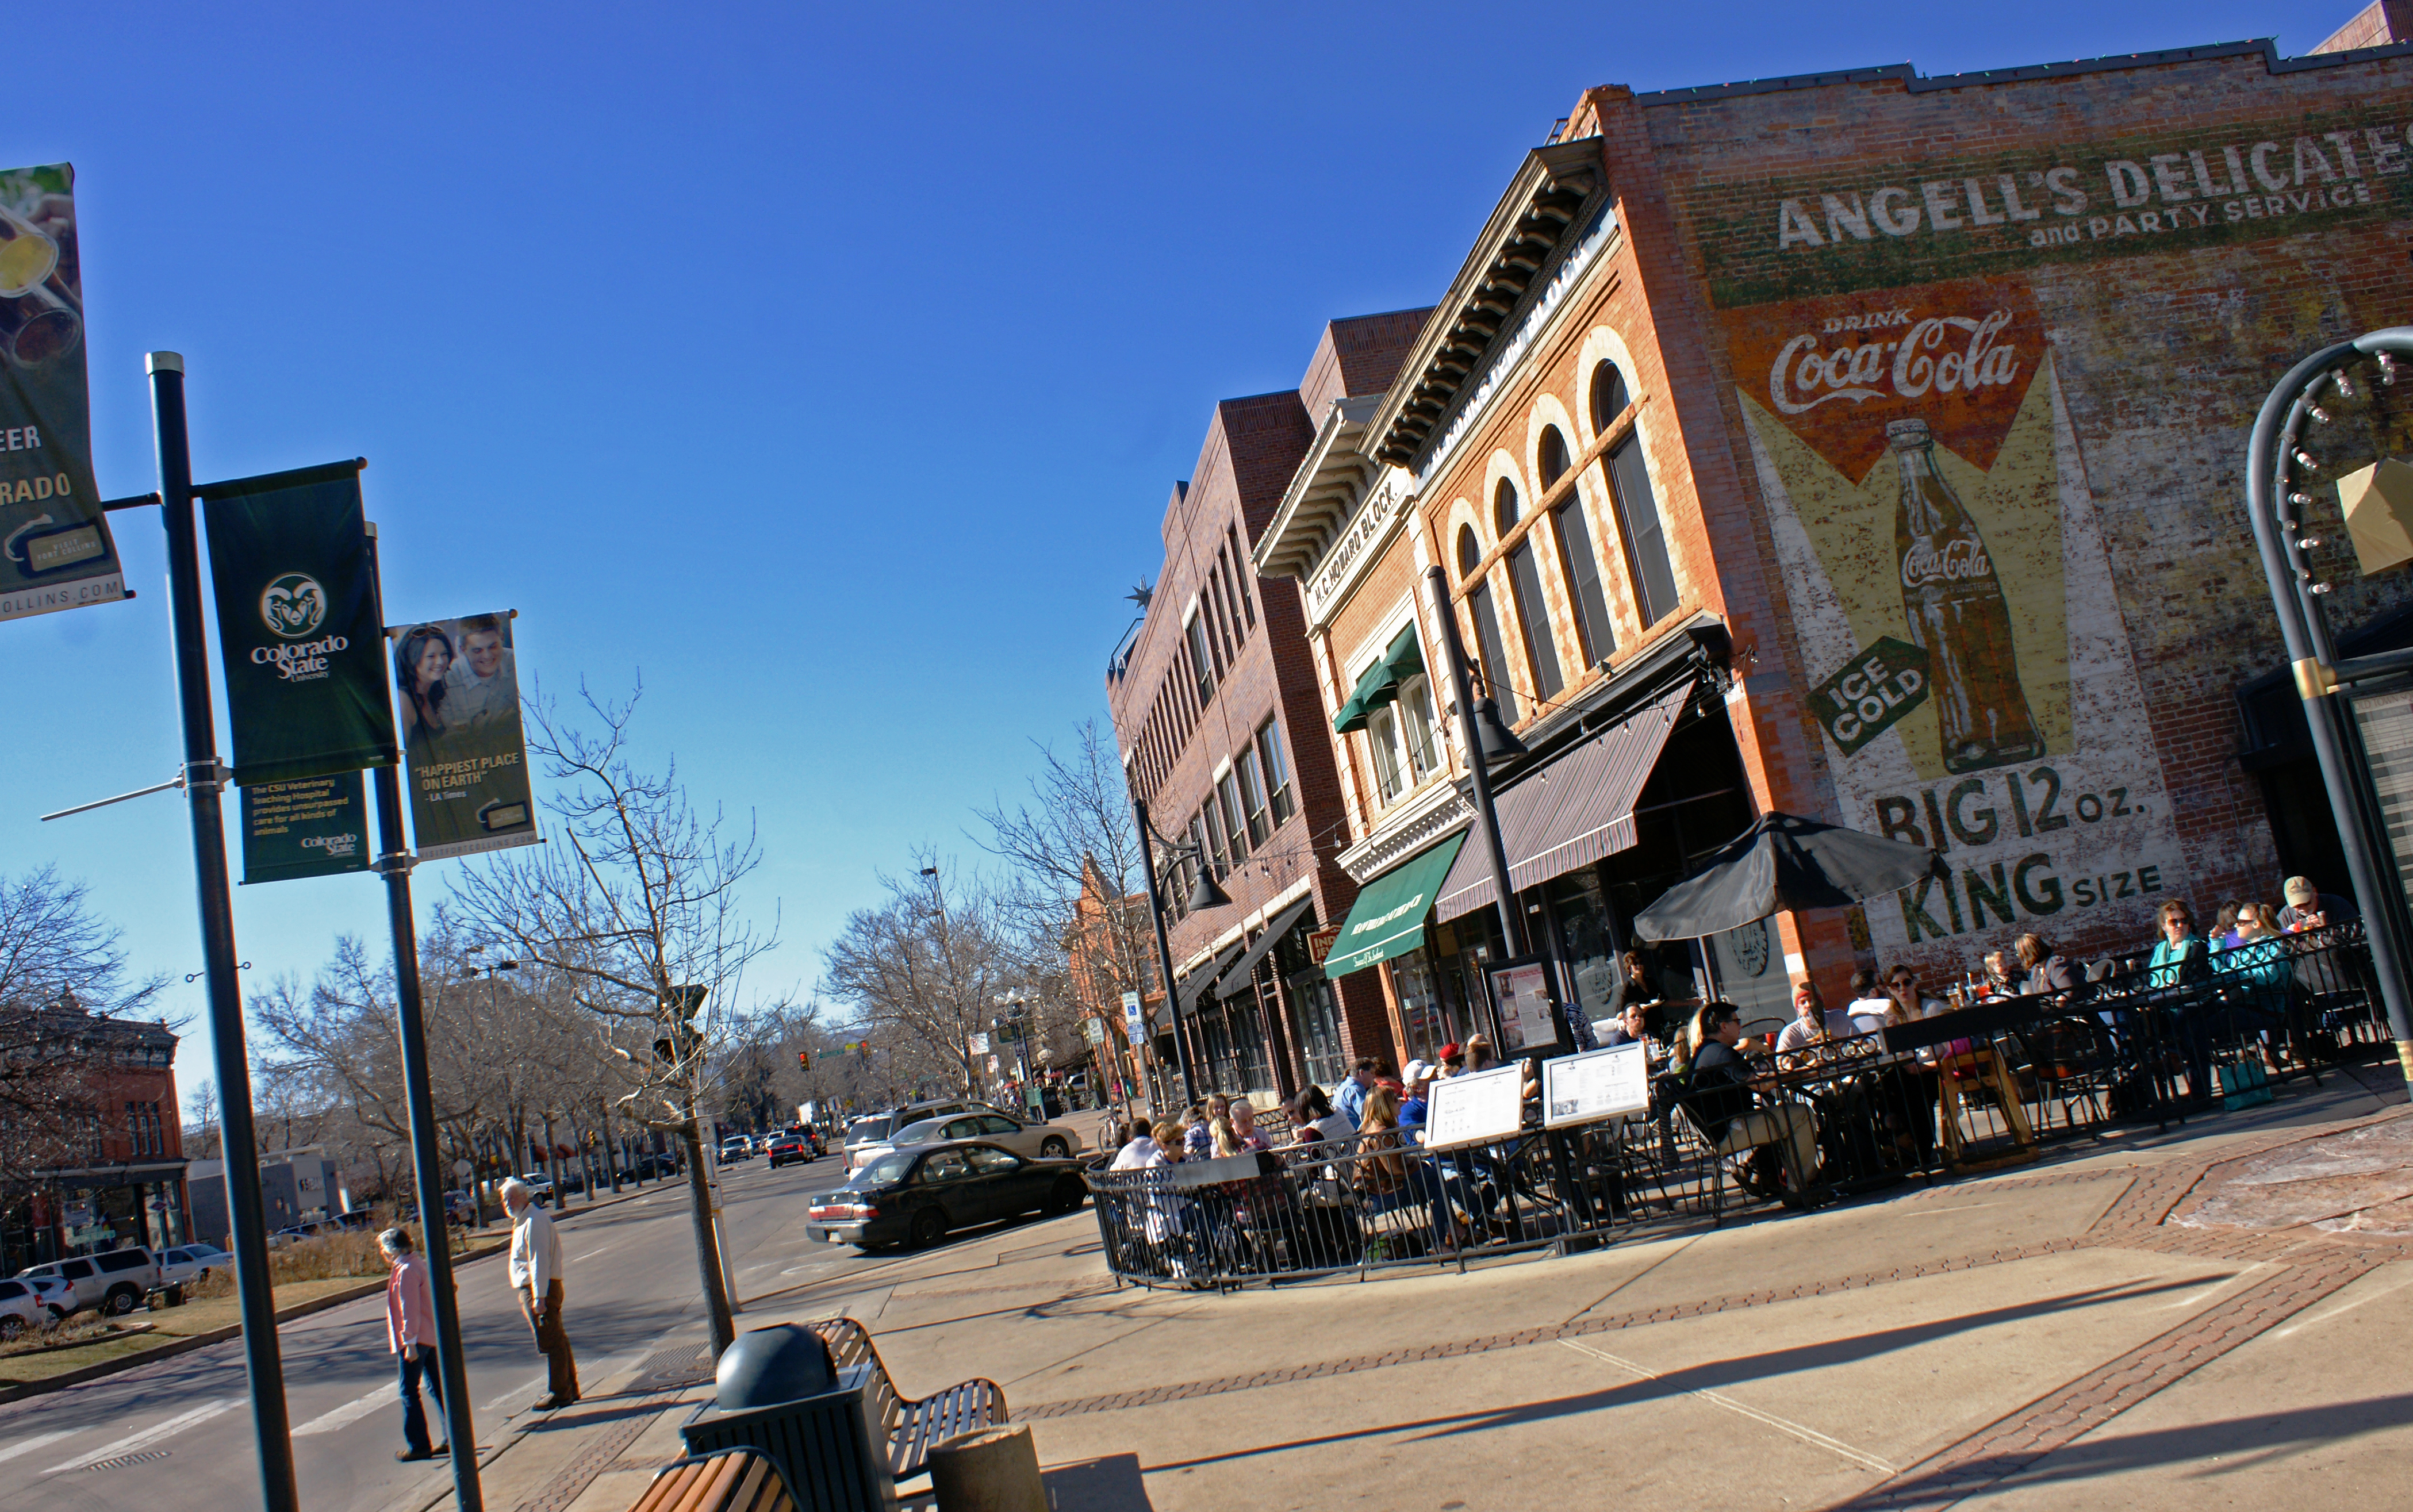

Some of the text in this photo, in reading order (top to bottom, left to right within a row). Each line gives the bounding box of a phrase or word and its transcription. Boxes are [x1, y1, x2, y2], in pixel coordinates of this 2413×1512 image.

[1779, 122, 2413, 249] ANGELL'S DELICATE
[2029, 182, 2371, 248] and PARTY SERVICE
[1823, 308, 1913, 333] DRINK
[0, 472, 71, 506] RADO
[37, 551, 58, 561] FORT
[1329, 530, 1361, 586] HOWARD
[250, 635, 349, 664] Colorado
[276, 655, 329, 679] State
[1827, 656, 1892, 711] ICE
[1832, 669, 1922, 742] COLD
[2354, 701, 2370, 711] OLD
[2373, 695, 2398, 707] TOWN
[480, 752, 520, 769] PLACE
[252, 779, 335, 795] The CSU Veterinary
[421, 778, 441, 791] ON
[252, 789, 329, 805] Teaching Hospital
[252, 796, 349, 817] provides unsurpassed
[429, 792, 443, 802] LA
[443, 790, 467, 800] Times
[253, 808, 337, 826] care for all kinds of
[1875, 778, 1998, 853] BIG
[2006, 766, 2069, 838] 12
[254, 825, 289, 836] animals
[301, 833, 358, 848] Colorado
[326, 843, 356, 855] State
[1897, 853, 2163, 944] KING SIZE
